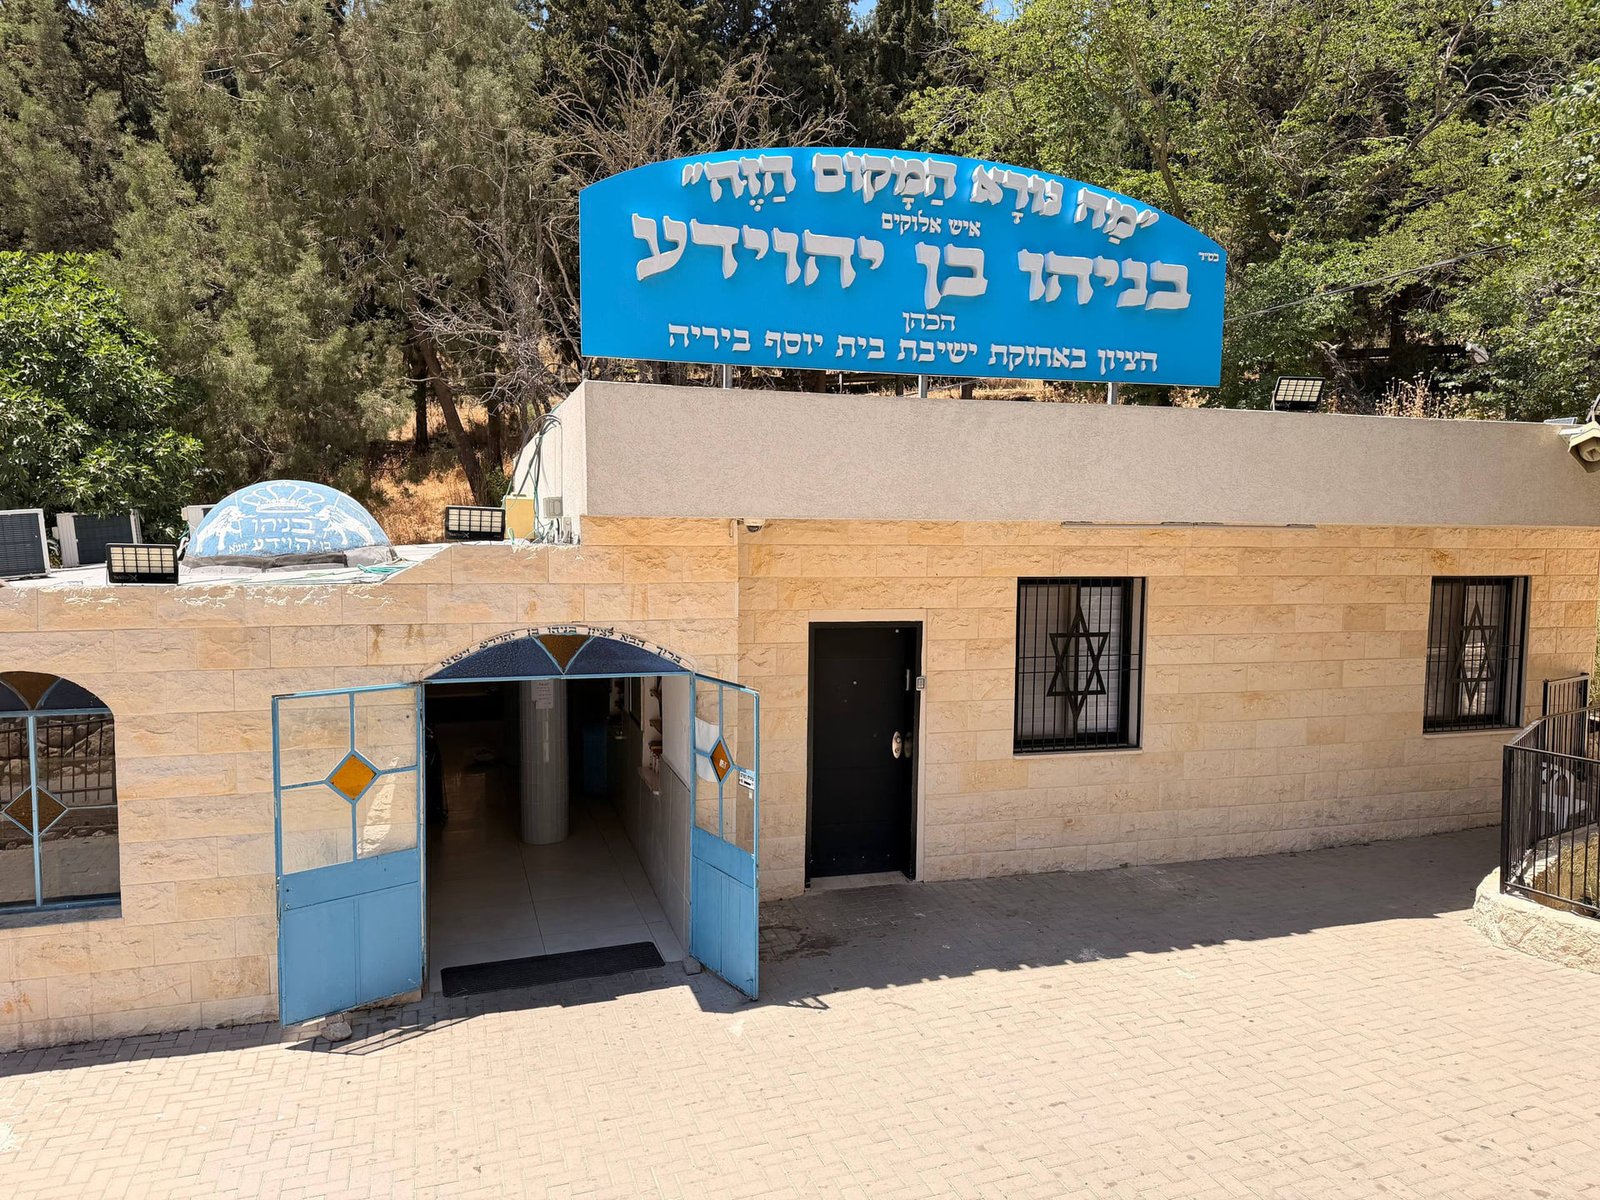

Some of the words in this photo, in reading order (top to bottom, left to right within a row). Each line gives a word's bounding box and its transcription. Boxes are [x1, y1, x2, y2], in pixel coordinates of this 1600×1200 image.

[881, 209, 942, 236] אלוקים
[948, 218, 982, 238] איש
[631, 213, 885, 289] יהוידע
[915, 241, 989, 310] בן
[1017, 248, 1192, 311] בניהו
[902, 311, 956, 334] הכהן
[668, 323, 751, 352] ביריה
[764, 330, 824, 359] יוסף
[835, 334, 886, 360] בית
[897, 338, 978, 364] ישיבת
[988, 343, 1087, 372] באחזקת
[1097, 348, 1158, 376] הציון
[252, 517, 316, 535] בניהו
[251, 537, 317, 552] יהוידע
[479, 632, 516, 650] יהוידע
[527, 627, 540, 637] בן
[547, 625, 577, 634] בניהו
[587, 626, 615, 638] לציון
[620, 634, 646, 648] הבא
[656, 645, 682, 664] ברוך
